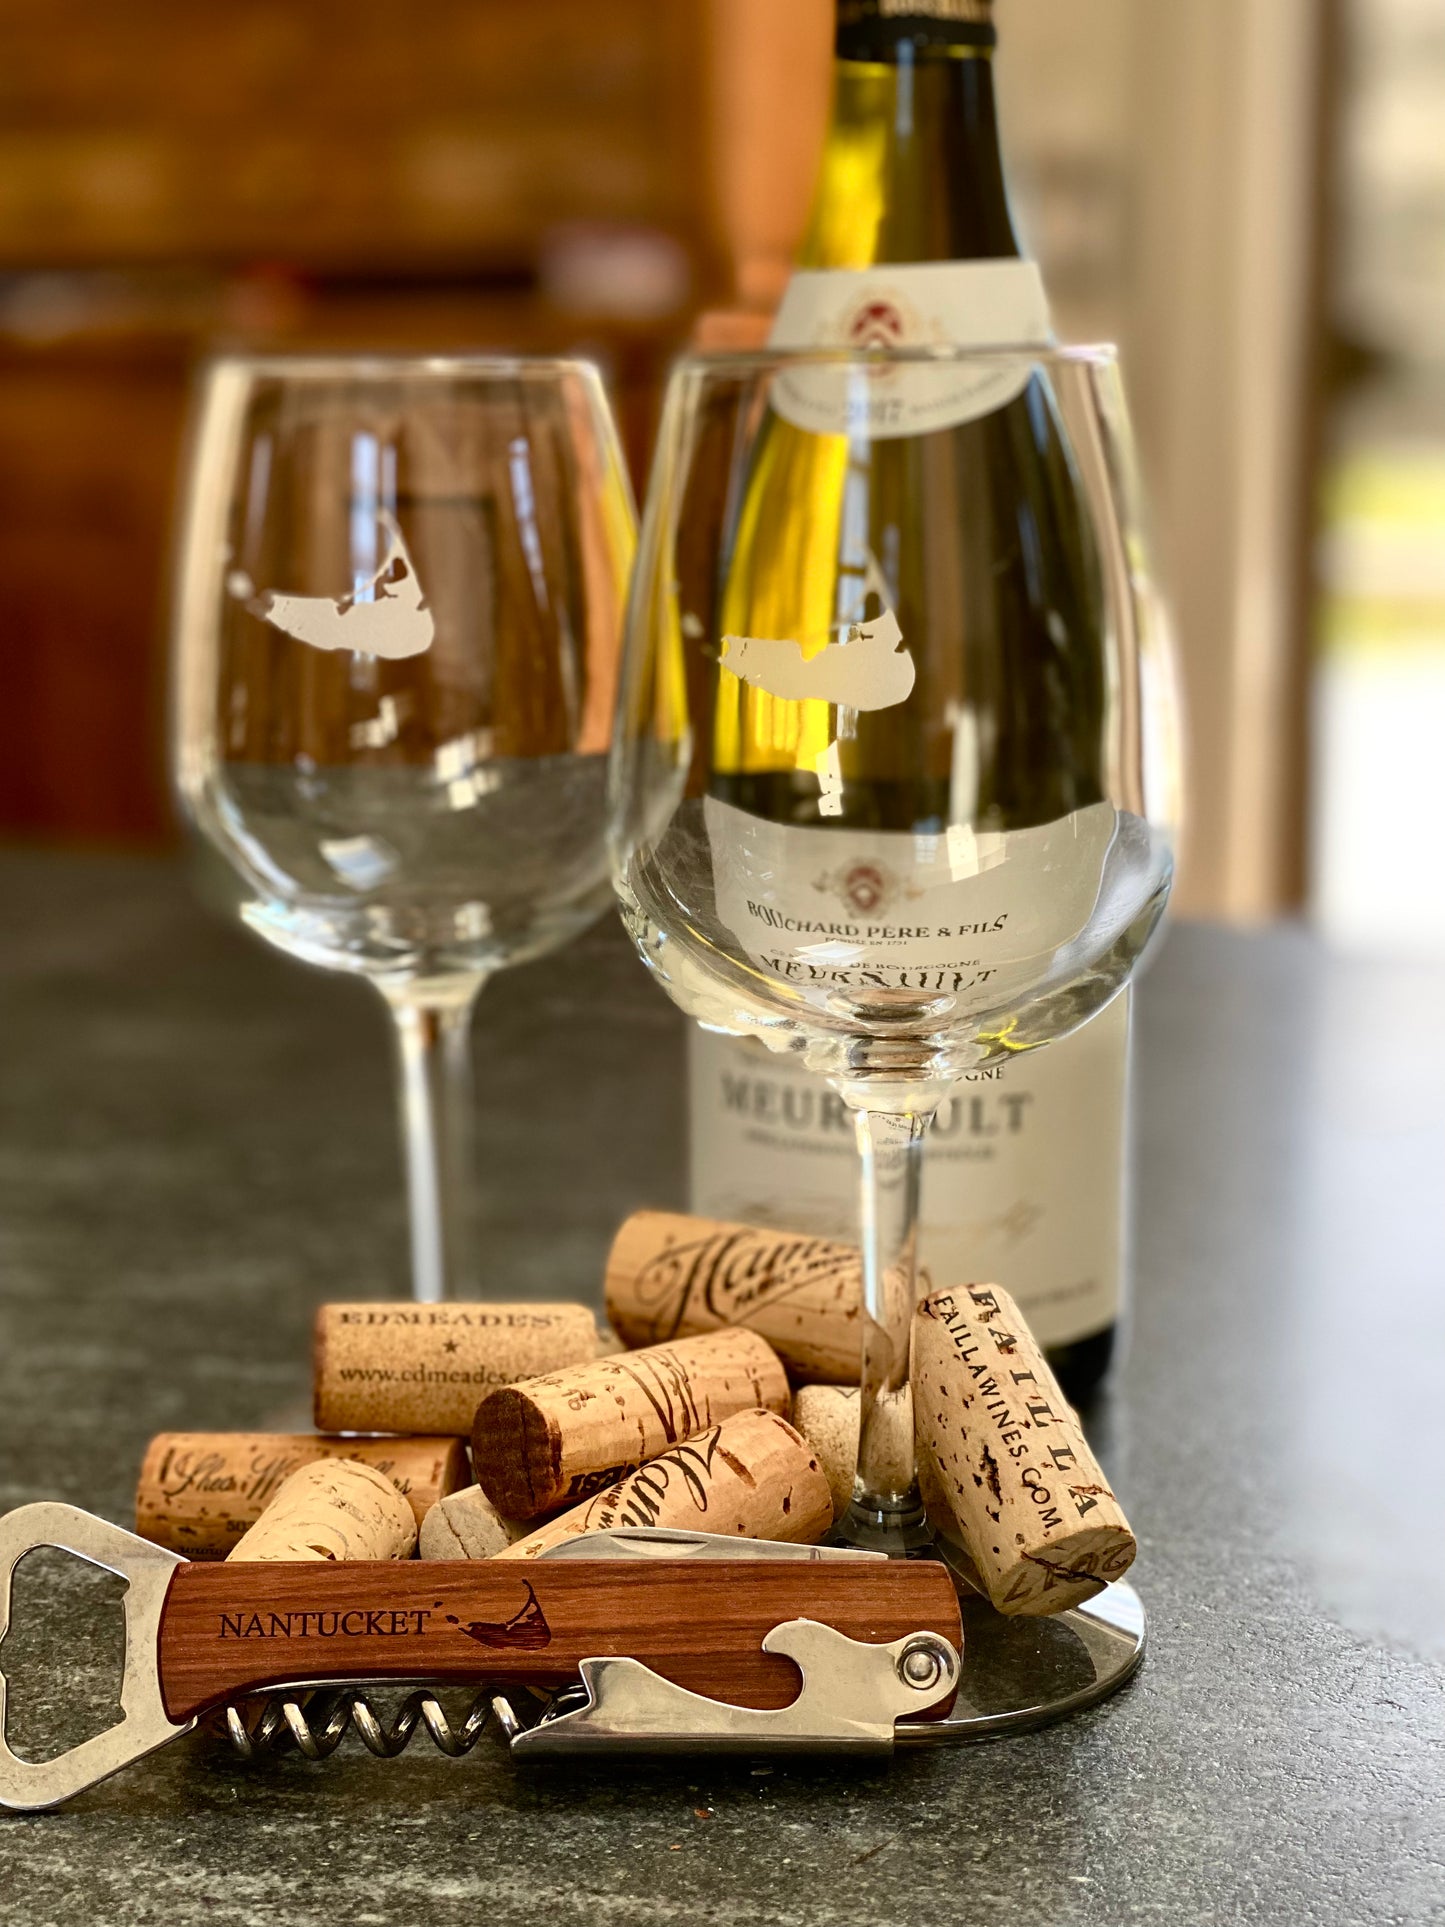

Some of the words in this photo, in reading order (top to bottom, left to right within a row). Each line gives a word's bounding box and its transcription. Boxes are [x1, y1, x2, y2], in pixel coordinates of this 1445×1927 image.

[747, 900, 859, 937] BOUCHARD
[937, 927, 951, 937] &
[959, 913, 1008, 936] FILS
[340, 1353, 550, 1386] www.edmeades.co
[968, 1290, 1099, 1519] FAILLA
[218, 1610, 432, 1639] NANTUCKET
